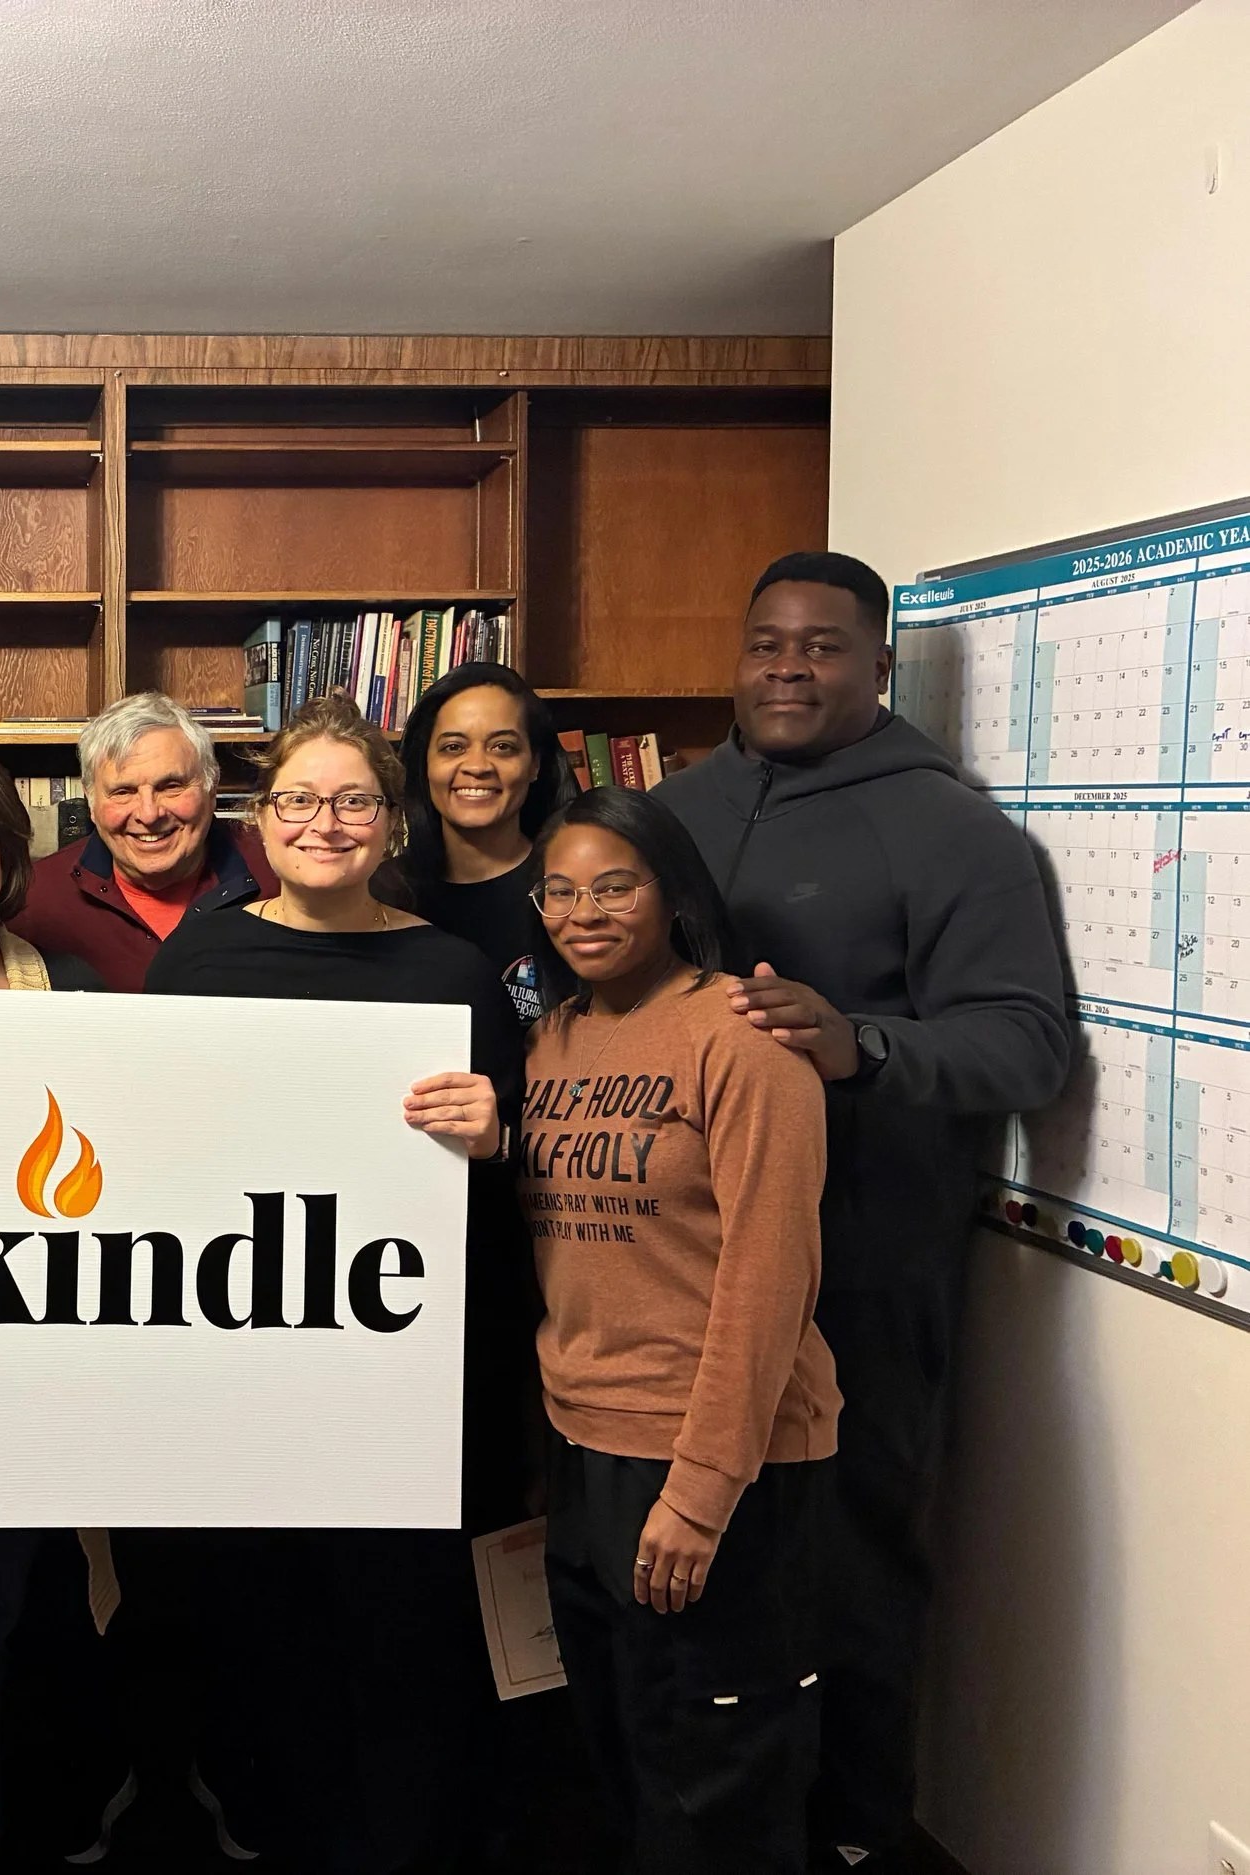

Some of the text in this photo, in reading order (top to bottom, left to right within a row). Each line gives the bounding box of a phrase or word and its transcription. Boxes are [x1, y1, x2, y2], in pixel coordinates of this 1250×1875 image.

[1072, 550, 1132, 575] 2025-2026
[1137, 533, 1214, 563] ACADEMIC
[1091, 576, 1118, 588] AUGUST
[1120, 573, 1136, 584] 2025
[900, 587, 955, 604] Exellewis
[313, 638, 320, 650] No
[422, 618, 438, 670] DICTIONARY
[1193, 661, 1227, 672] 14 15
[309, 670, 317, 681] No
[1075, 677, 1082, 685] 12
[1119, 672, 1126, 680] 14
[1141, 669, 1148, 678] 15
[1190, 705, 1198, 713] 21
[1216, 703, 1224, 711] 22
[1053, 715, 1059, 723] 18
[1094, 712, 1101, 720] 20
[1116, 710, 1123, 718] 21
[1138, 708, 1146, 717] 22
[1214, 744, 1222, 752] 29
[1240, 743, 1248, 751] 30
[1050, 751, 1057, 759] 25
[1071, 750, 1078, 758] 26
[1092, 749, 1099, 757] 27
[1074, 792, 1128, 801] DECEMBER 2025
[1133, 852, 1139, 860] 12
[1152, 892, 1161, 900] 20
[1207, 896, 1215, 904] 12
[1084, 924, 1092, 932] 24
[1151, 931, 1160, 940] 27
[1231, 940, 1240, 948] 20
[1179, 974, 1238, 989] 25 26 27
[505, 983, 540, 1004] ULTURAL
[1077, 1003, 1110, 1014] PRIL 2026
[1125, 1108, 1130, 1116] 17
[1200, 1127, 1207, 1135] 11
[1227, 1134, 1234, 1143] 12
[520, 1131, 656, 1184] ALFHOLY
[1174, 1160, 1182, 1168] 17
[564, 1194, 586, 1213] PRAY
[591, 1195, 629, 1215] WITH
[636, 1198, 660, 1217] ME
[575, 1222, 610, 1242] WITH
[613, 1224, 636, 1243] ME
